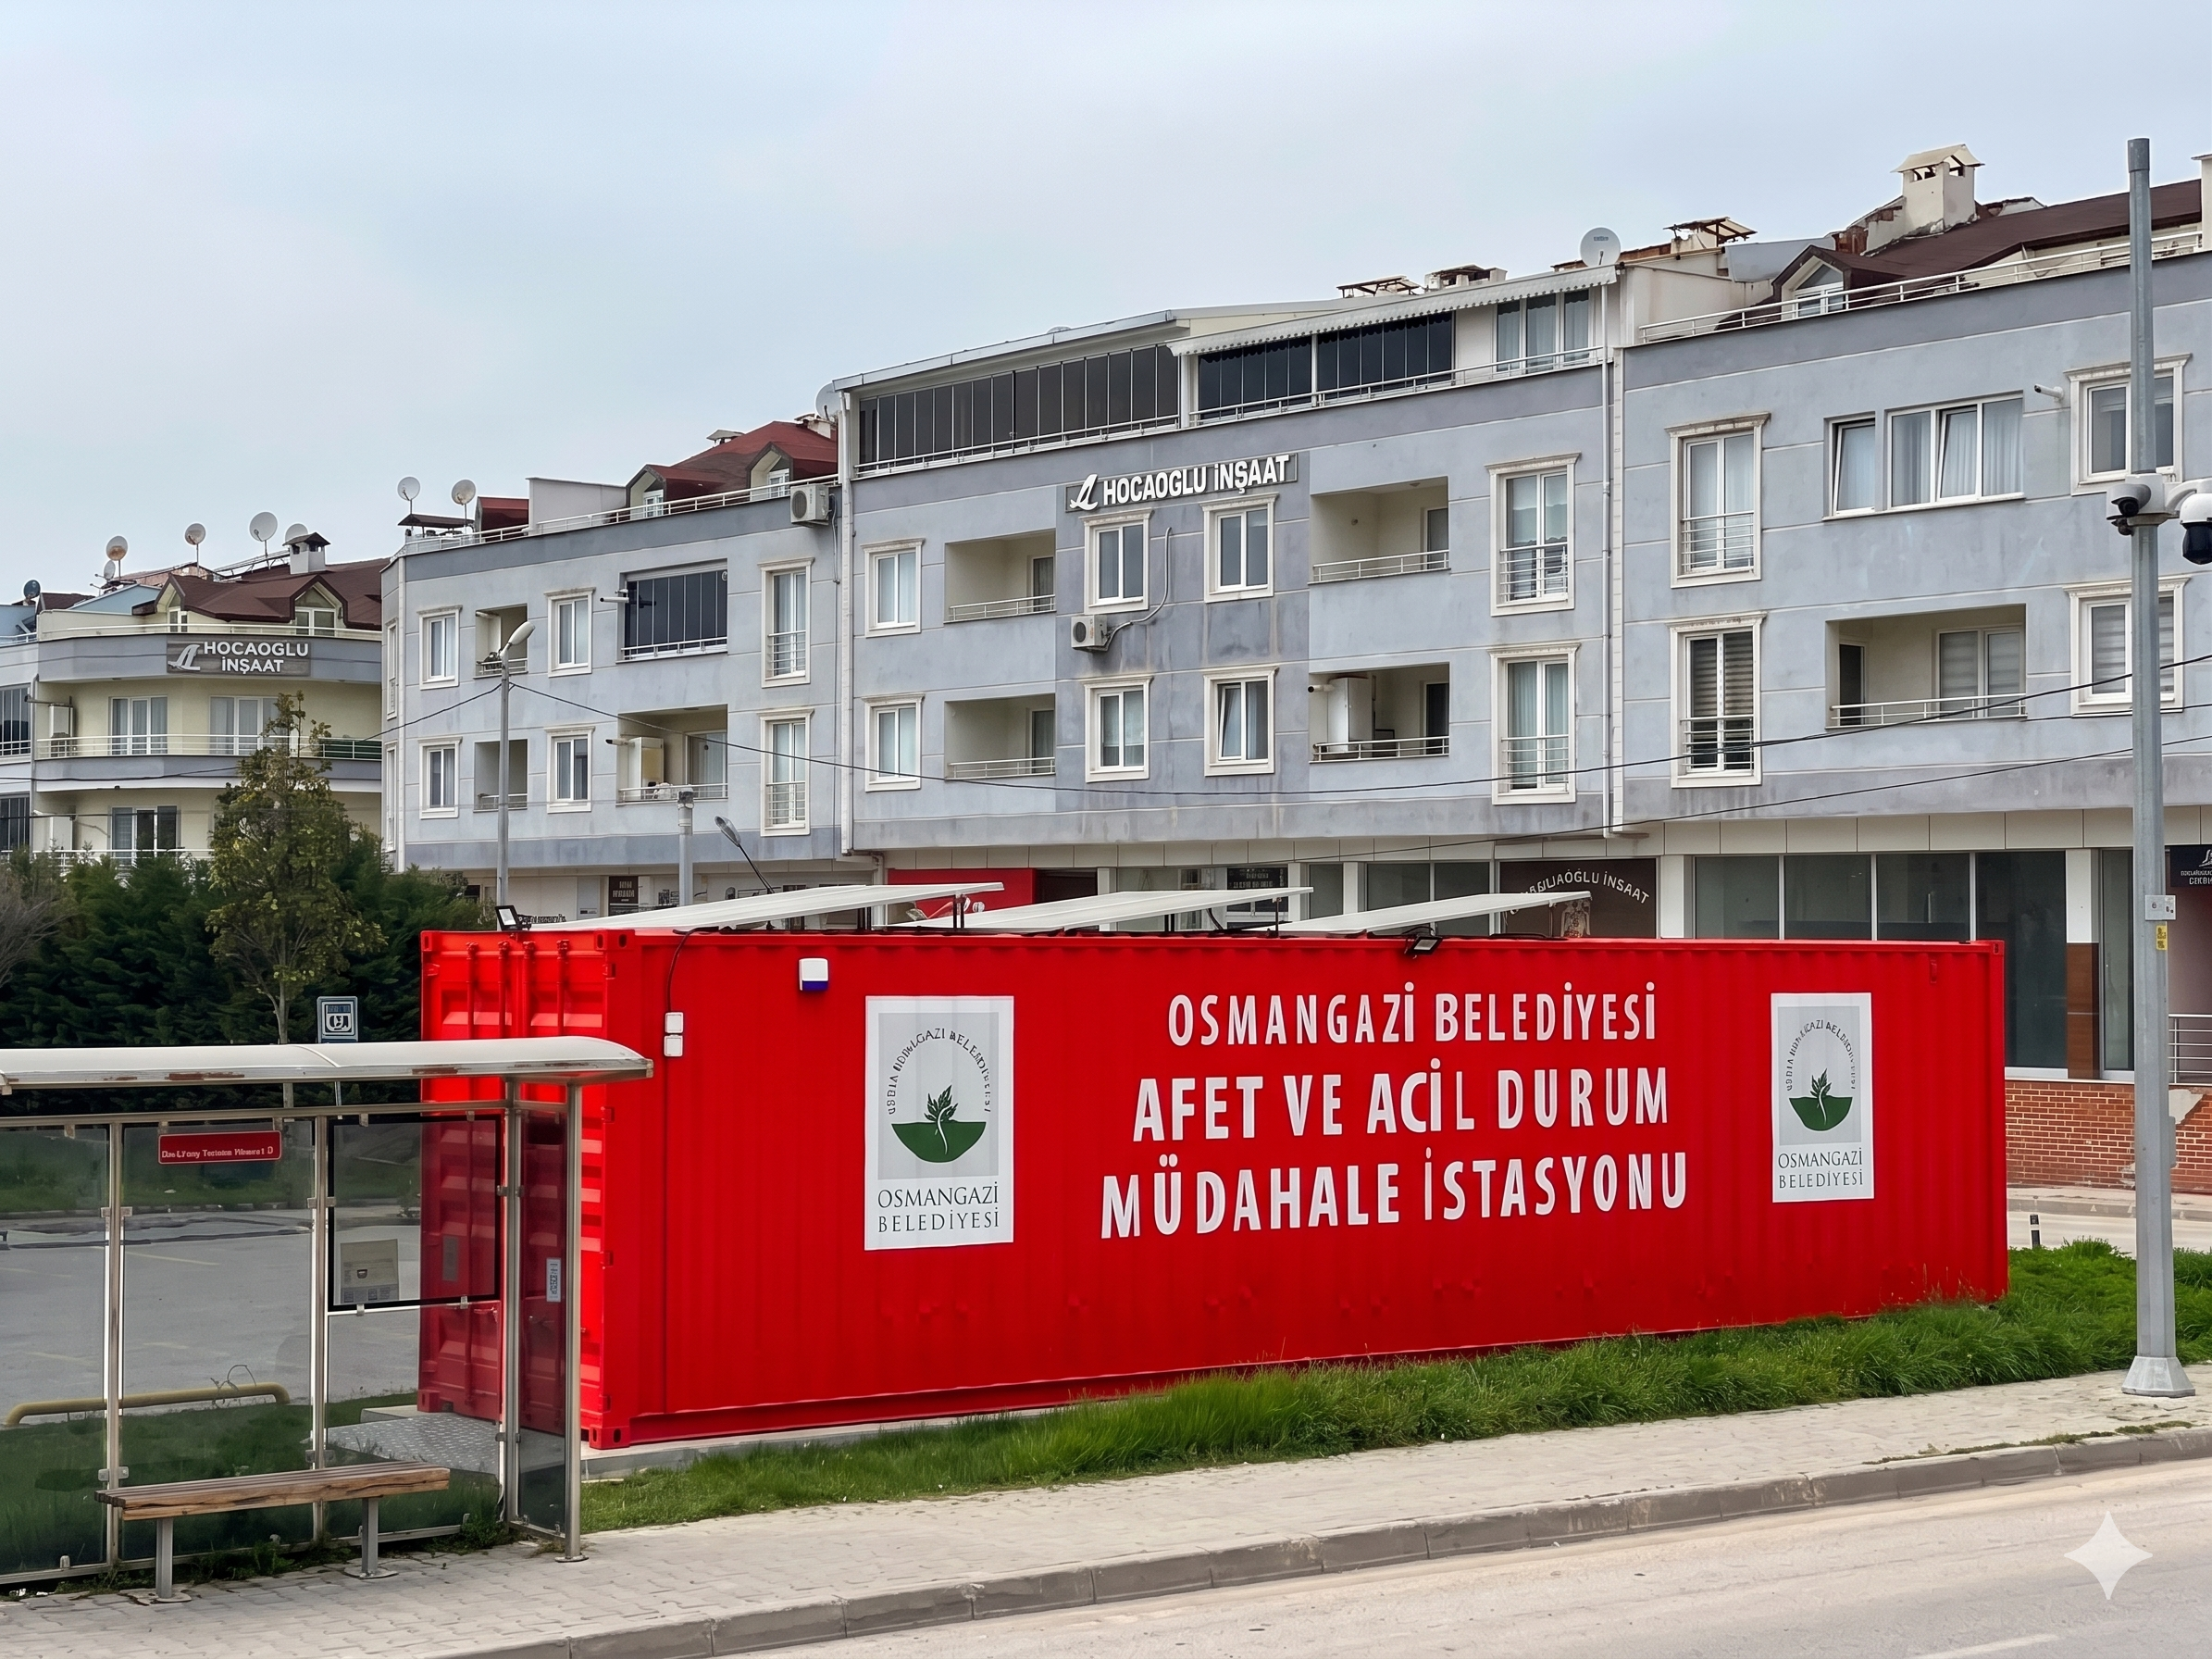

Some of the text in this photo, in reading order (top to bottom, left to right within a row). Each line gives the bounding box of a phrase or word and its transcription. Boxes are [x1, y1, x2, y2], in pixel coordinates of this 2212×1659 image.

[1103, 455, 1290, 506] HOCAOGLU İNŞAAT
[204, 641, 309, 675] HOCAOGLU İNŞAAT
[1168, 981, 1656, 1045] OSMANGAZİ BELEDİYESİ
[1133, 1057, 1668, 1141] AFET VE ACİL DURUM
[1778, 1147, 1863, 1168] OSMANGAZİ
[877, 1181, 1000, 1208] OSMANGAZİ
[1100, 1146, 1687, 1239] MÜDAHALE İSTASYONU
[1779, 1168, 1863, 1189] BELEDİYESİ
[878, 1208, 1000, 1233] BELEDİYESİ
